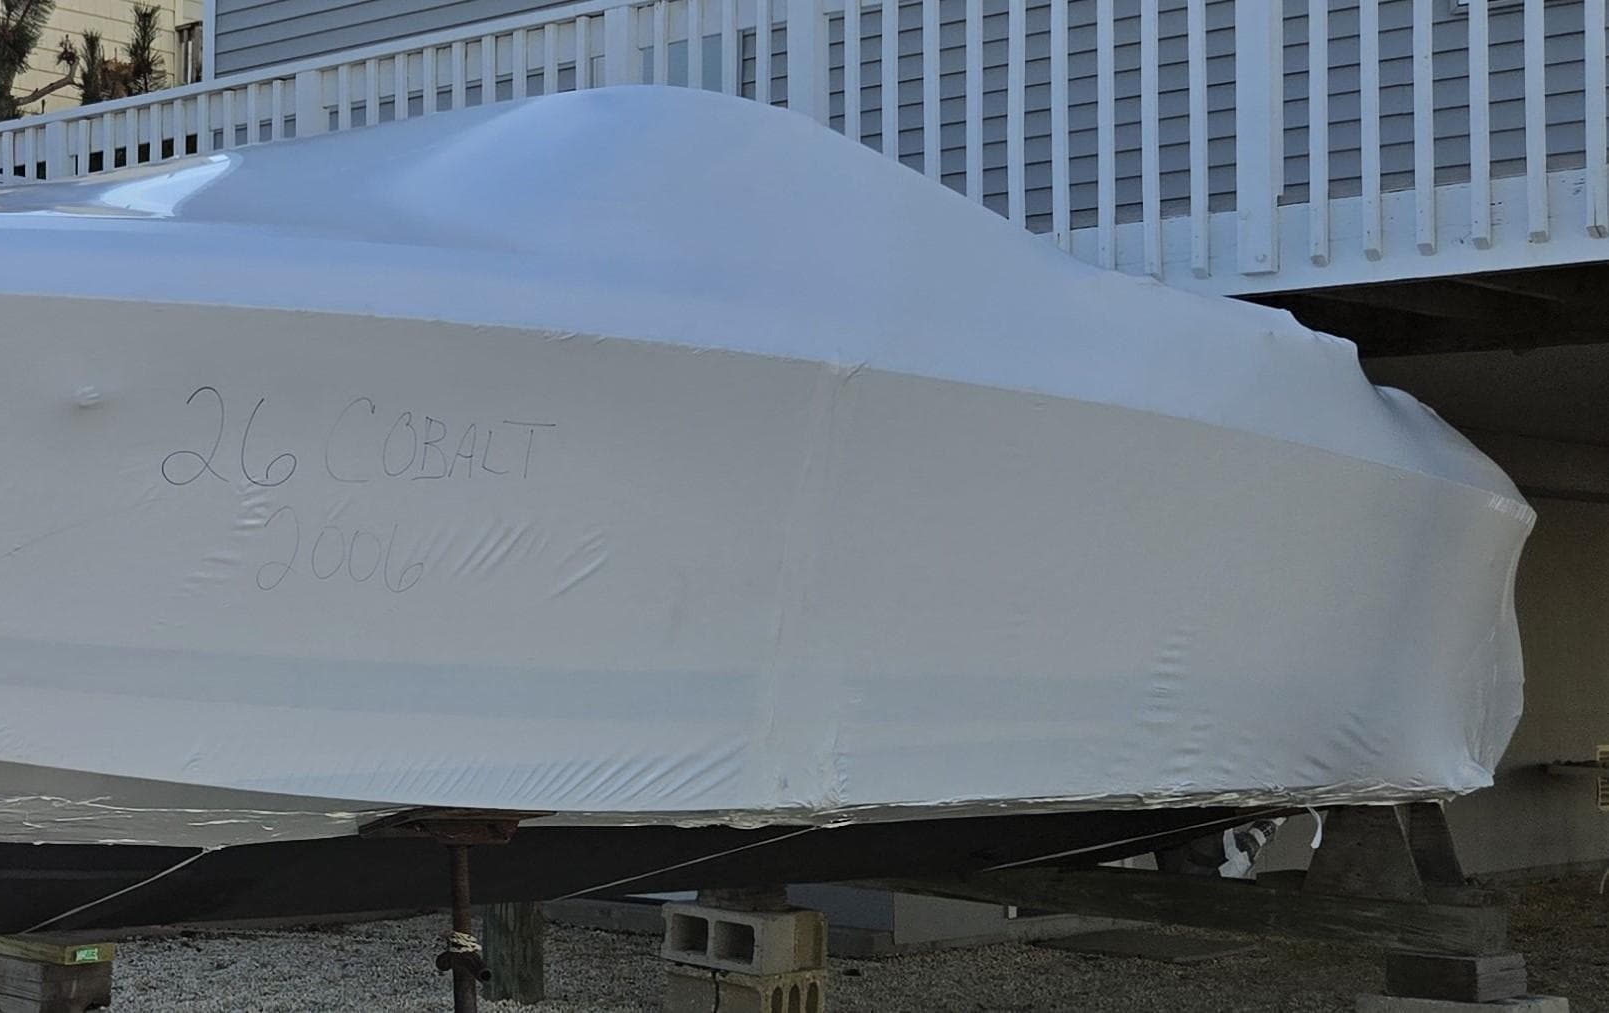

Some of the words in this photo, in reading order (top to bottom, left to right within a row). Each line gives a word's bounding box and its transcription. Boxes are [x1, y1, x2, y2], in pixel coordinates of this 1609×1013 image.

[161, 385, 297, 487] 26
[324, 396, 557, 483] COBALT
[255, 505, 425, 593] 2006
